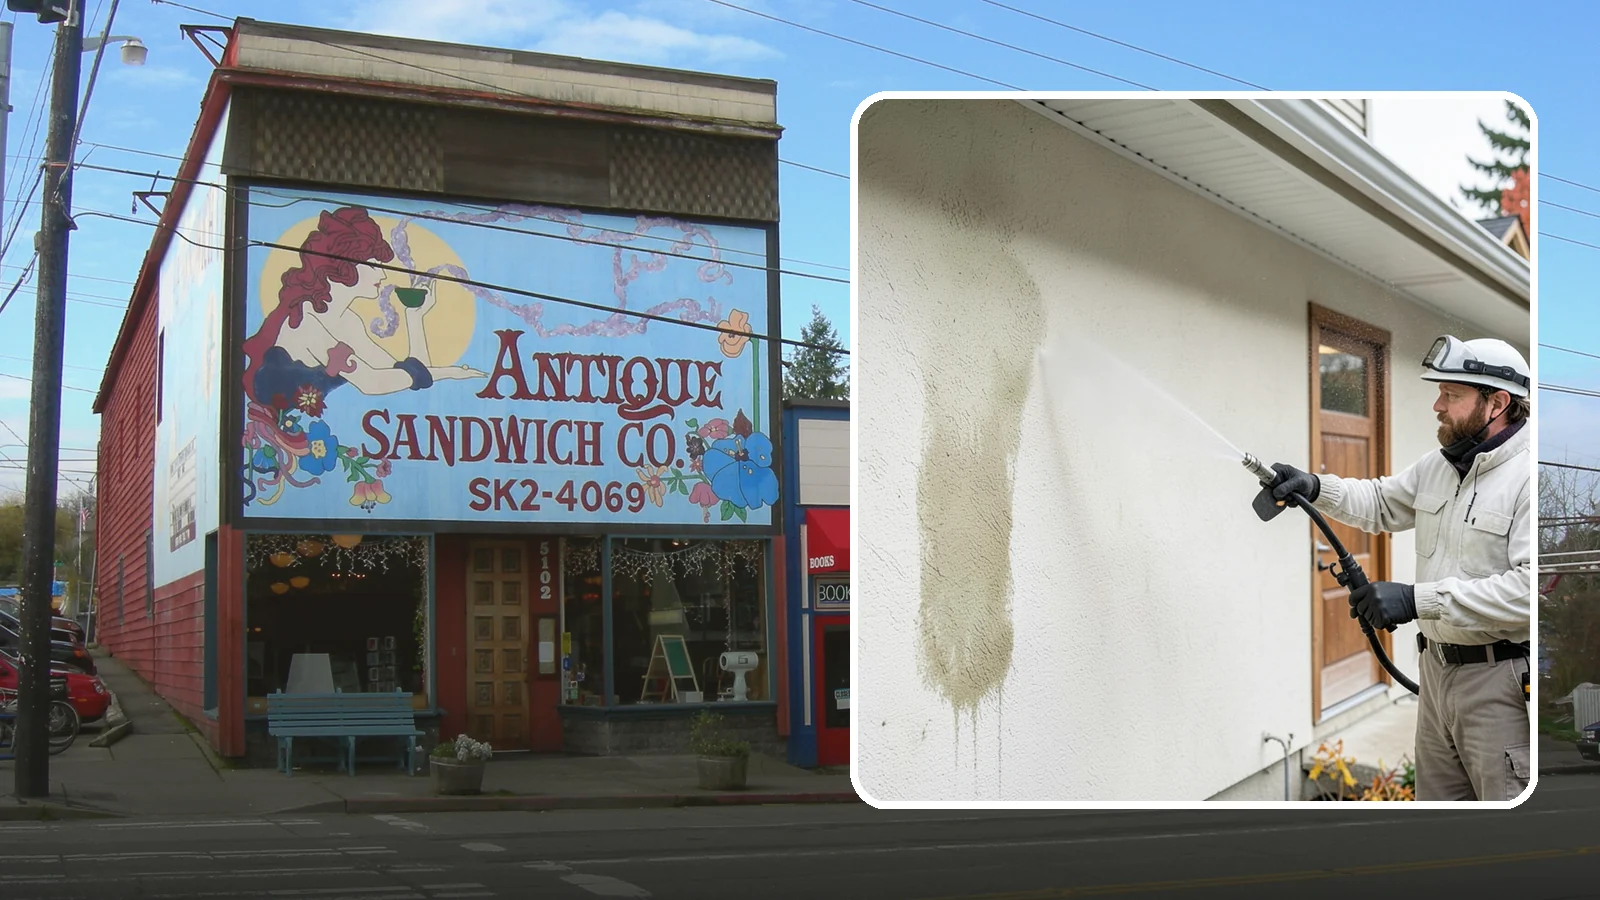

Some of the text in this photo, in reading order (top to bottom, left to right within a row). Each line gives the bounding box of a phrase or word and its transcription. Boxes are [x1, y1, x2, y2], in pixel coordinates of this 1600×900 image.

[475, 329, 724, 421] ANTIQUE
[361, 408, 685, 469] SANDWICH CO.
[468, 477, 646, 512] SK2-4069
[540, 541, 551, 599] 5102
[809, 555, 835, 568] BOOKS
